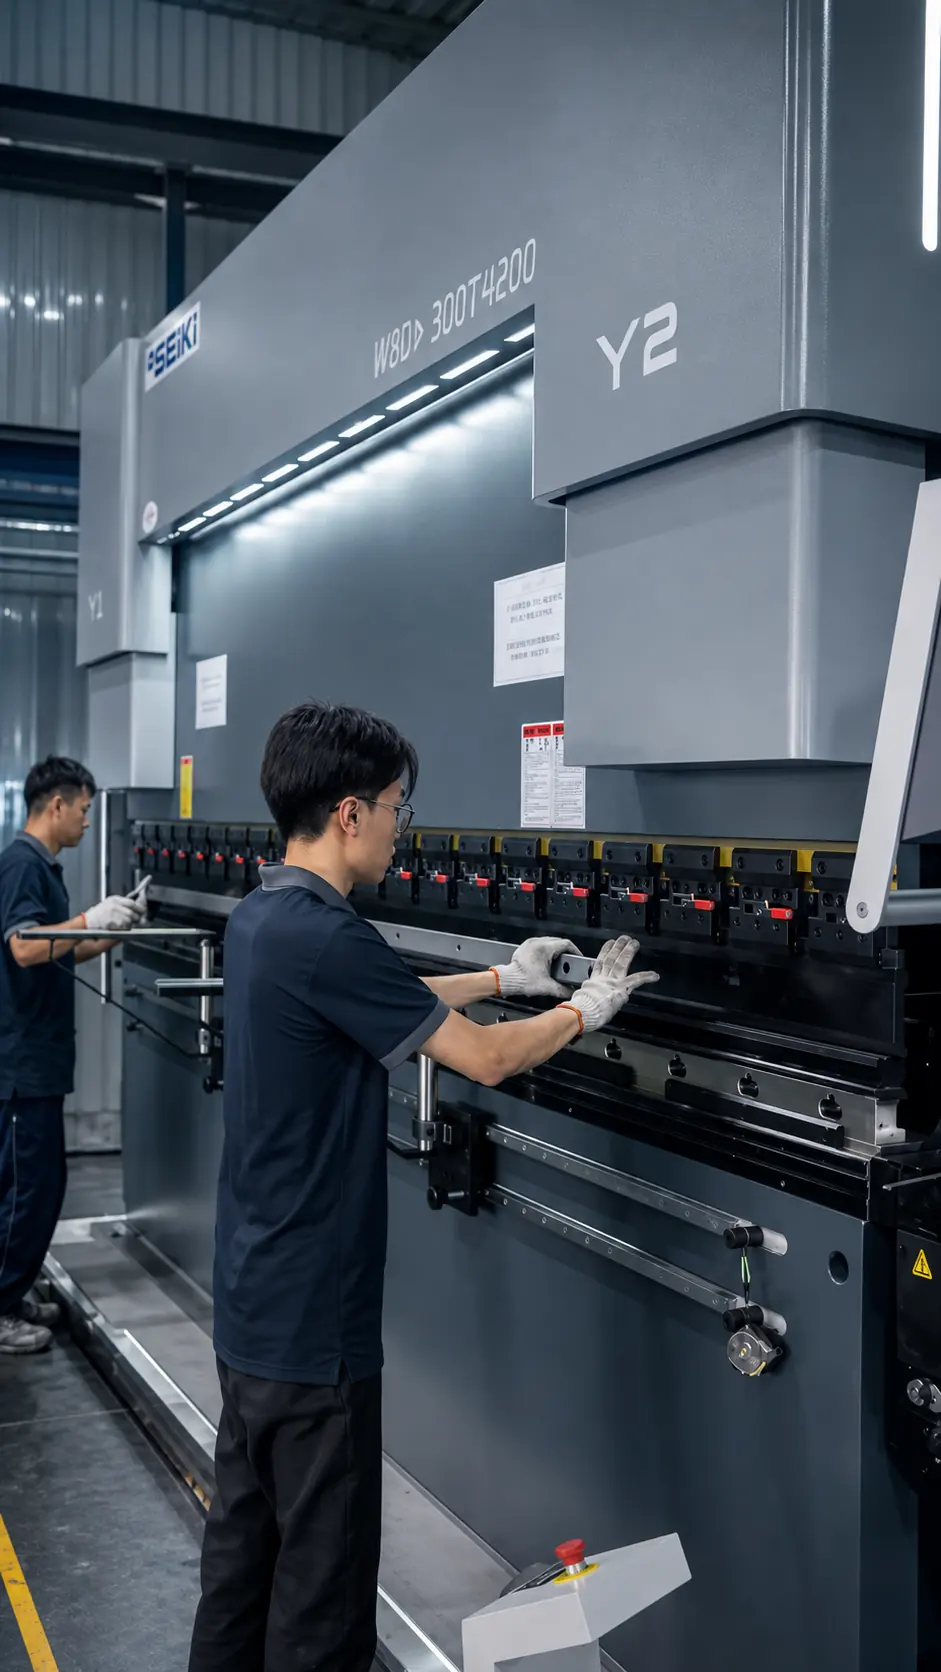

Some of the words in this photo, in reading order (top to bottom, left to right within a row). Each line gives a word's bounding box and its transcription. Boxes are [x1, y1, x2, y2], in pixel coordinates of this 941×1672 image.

[431, 238, 536, 343] 300T4200
[596, 302, 678, 391] Y2
[88, 591, 102, 622] Y1
